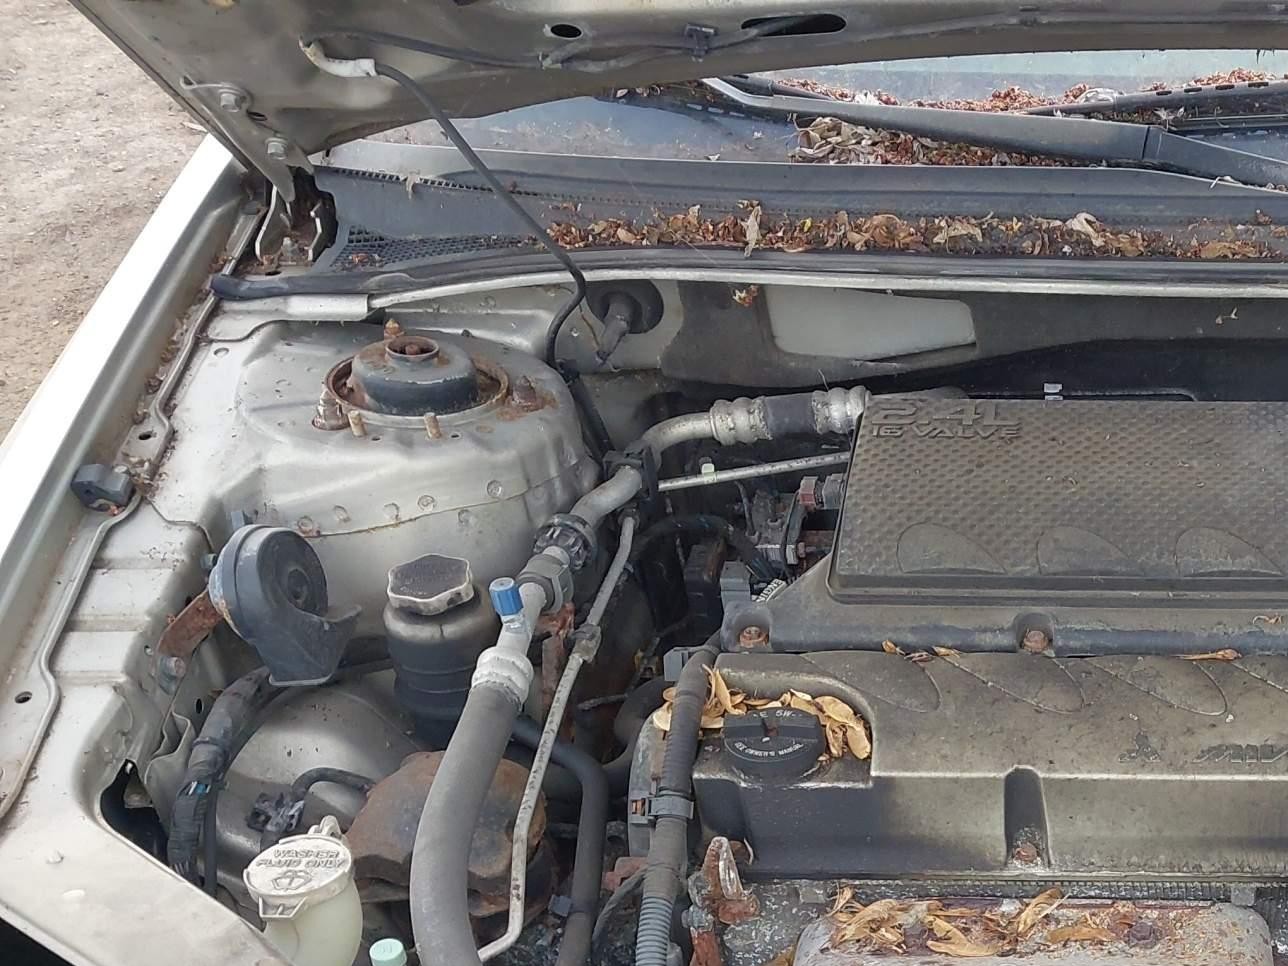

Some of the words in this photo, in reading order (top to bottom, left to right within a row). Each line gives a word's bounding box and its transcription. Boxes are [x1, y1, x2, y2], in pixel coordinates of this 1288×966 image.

[872, 404, 1022, 425] 2.4L
[872, 426, 904, 438] 16
[912, 426, 1022, 438] VALVE
[273, 848, 340, 859] WASHER
[255, 858, 303, 868] FLUID
[304, 858, 347, 869] ONLY
